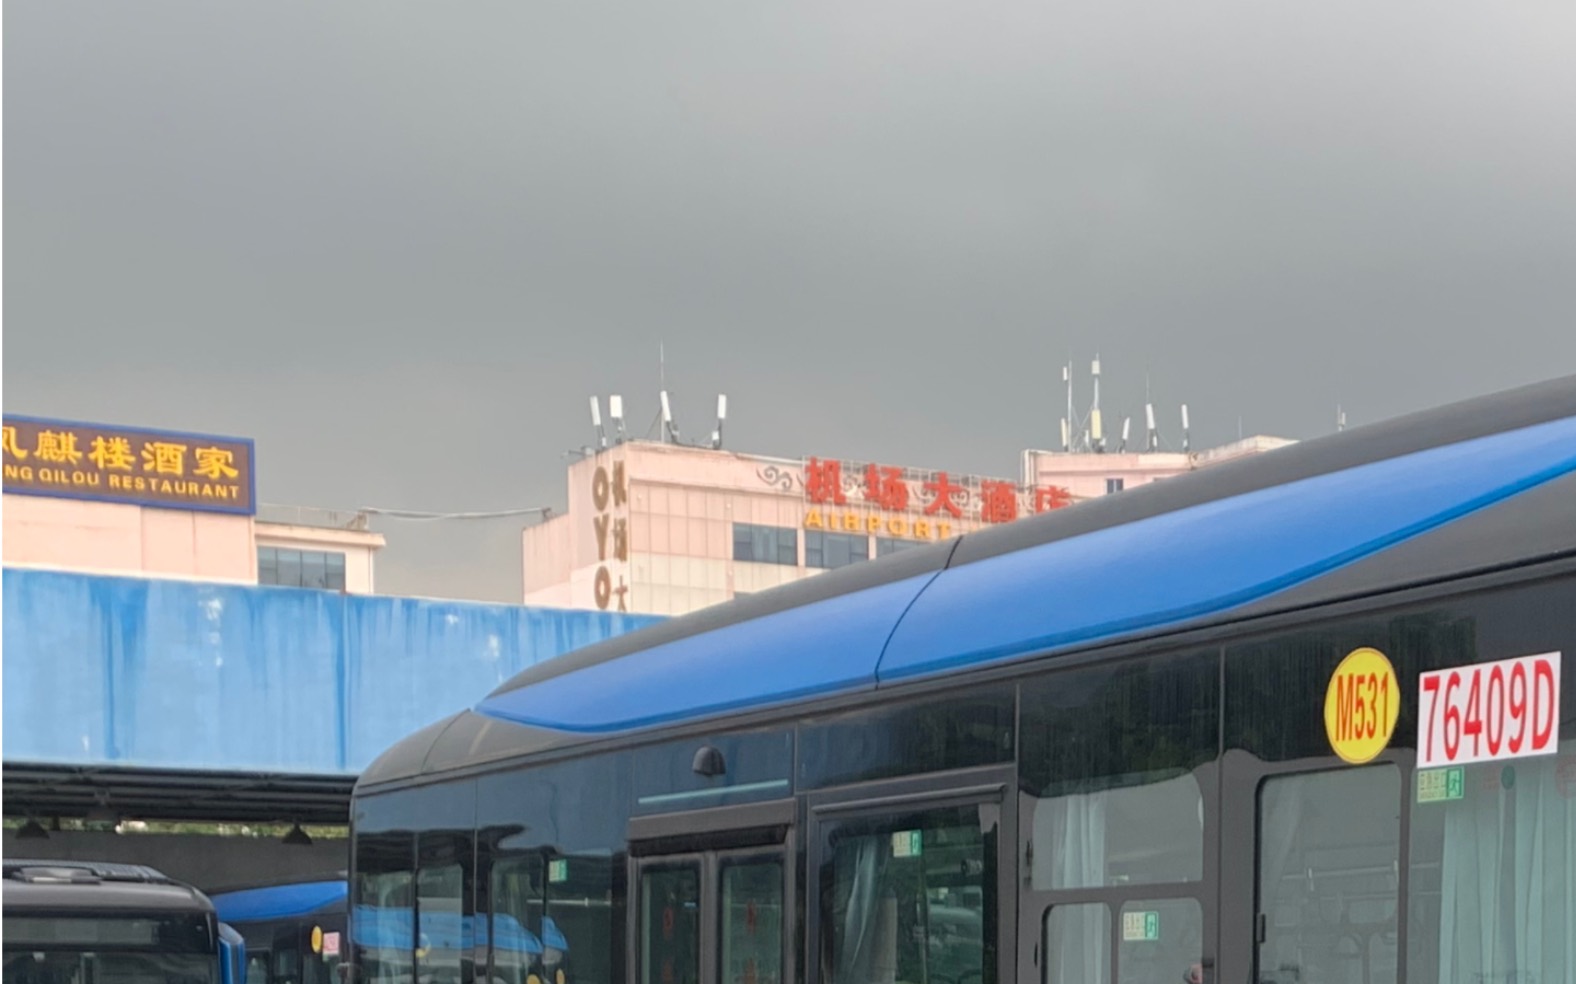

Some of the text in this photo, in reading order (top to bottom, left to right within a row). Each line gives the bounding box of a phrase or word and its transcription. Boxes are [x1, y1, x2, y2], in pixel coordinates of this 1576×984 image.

[38, 466, 101, 485] QILOU
[108, 472, 241, 499] RESTAURANT
[592, 465, 612, 610] OYO
[803, 508, 952, 541] AIRPORT
[1336, 671, 1391, 743] M531
[1422, 659, 1554, 763] 76409D
